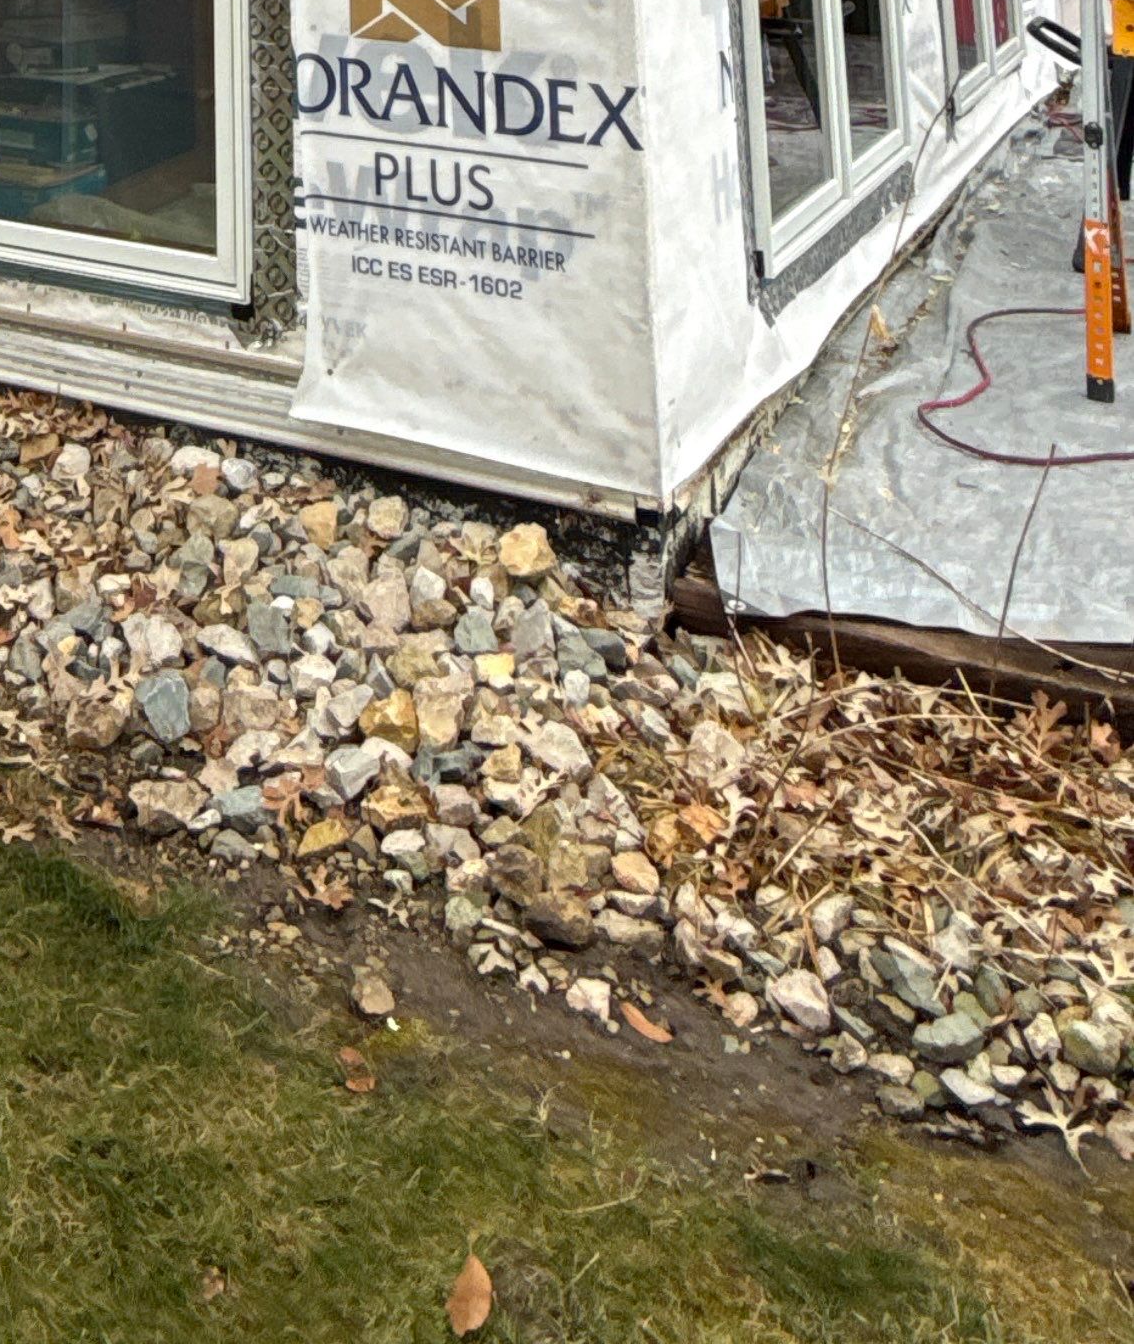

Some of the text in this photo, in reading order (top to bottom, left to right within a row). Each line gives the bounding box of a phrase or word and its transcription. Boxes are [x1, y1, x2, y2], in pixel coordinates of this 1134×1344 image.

[297, 52, 645, 152] ORANDEX
[373, 150, 495, 212] PLUS
[310, 214, 566, 273] WEATHER RESISTANT BARRIER
[351, 254, 383, 277] ICC
[387, 260, 413, 282] ES
